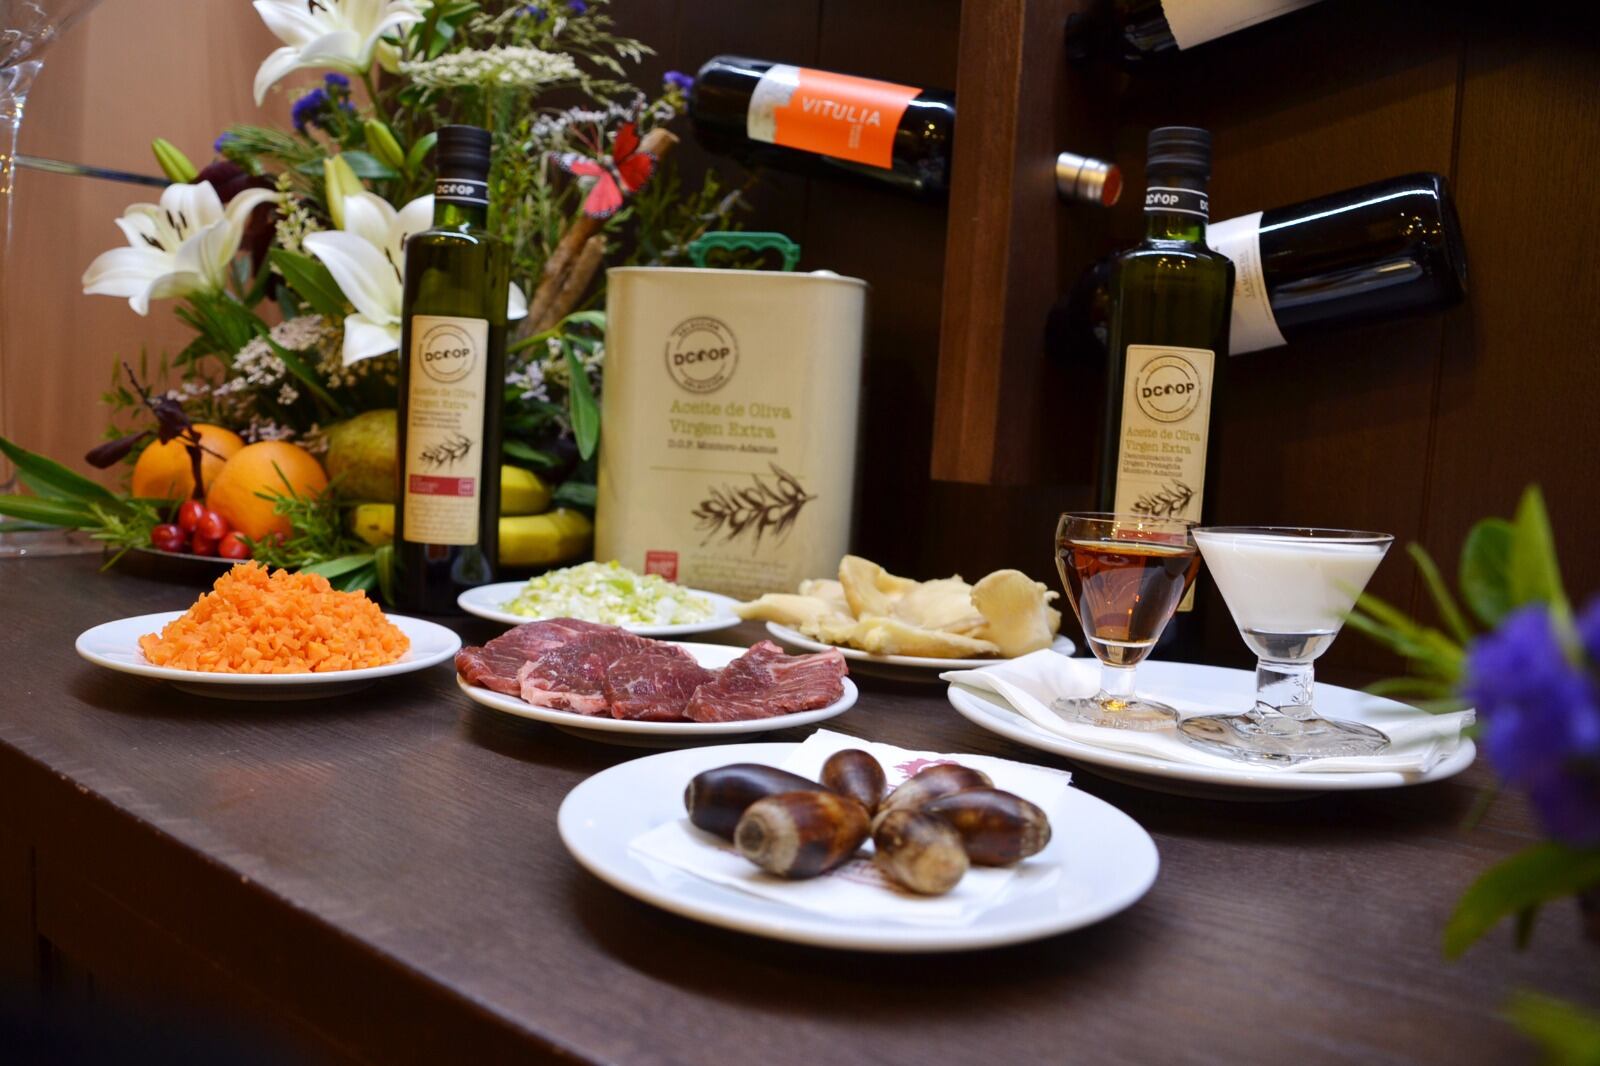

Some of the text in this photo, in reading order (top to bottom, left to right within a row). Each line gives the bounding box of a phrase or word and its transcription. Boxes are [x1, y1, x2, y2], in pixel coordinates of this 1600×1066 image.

[802, 95, 881, 128] VITULIA
[674, 347, 730, 366] DCOOP
[1142, 382, 1195, 399] DCOOP
[670, 400, 792, 419] Aceite de Oliva
[668, 419, 776, 439] Virgen Extra
[1126, 427, 1201, 442] Aceite de Oliva
[1126, 440, 1192, 455] Virgen Extra
